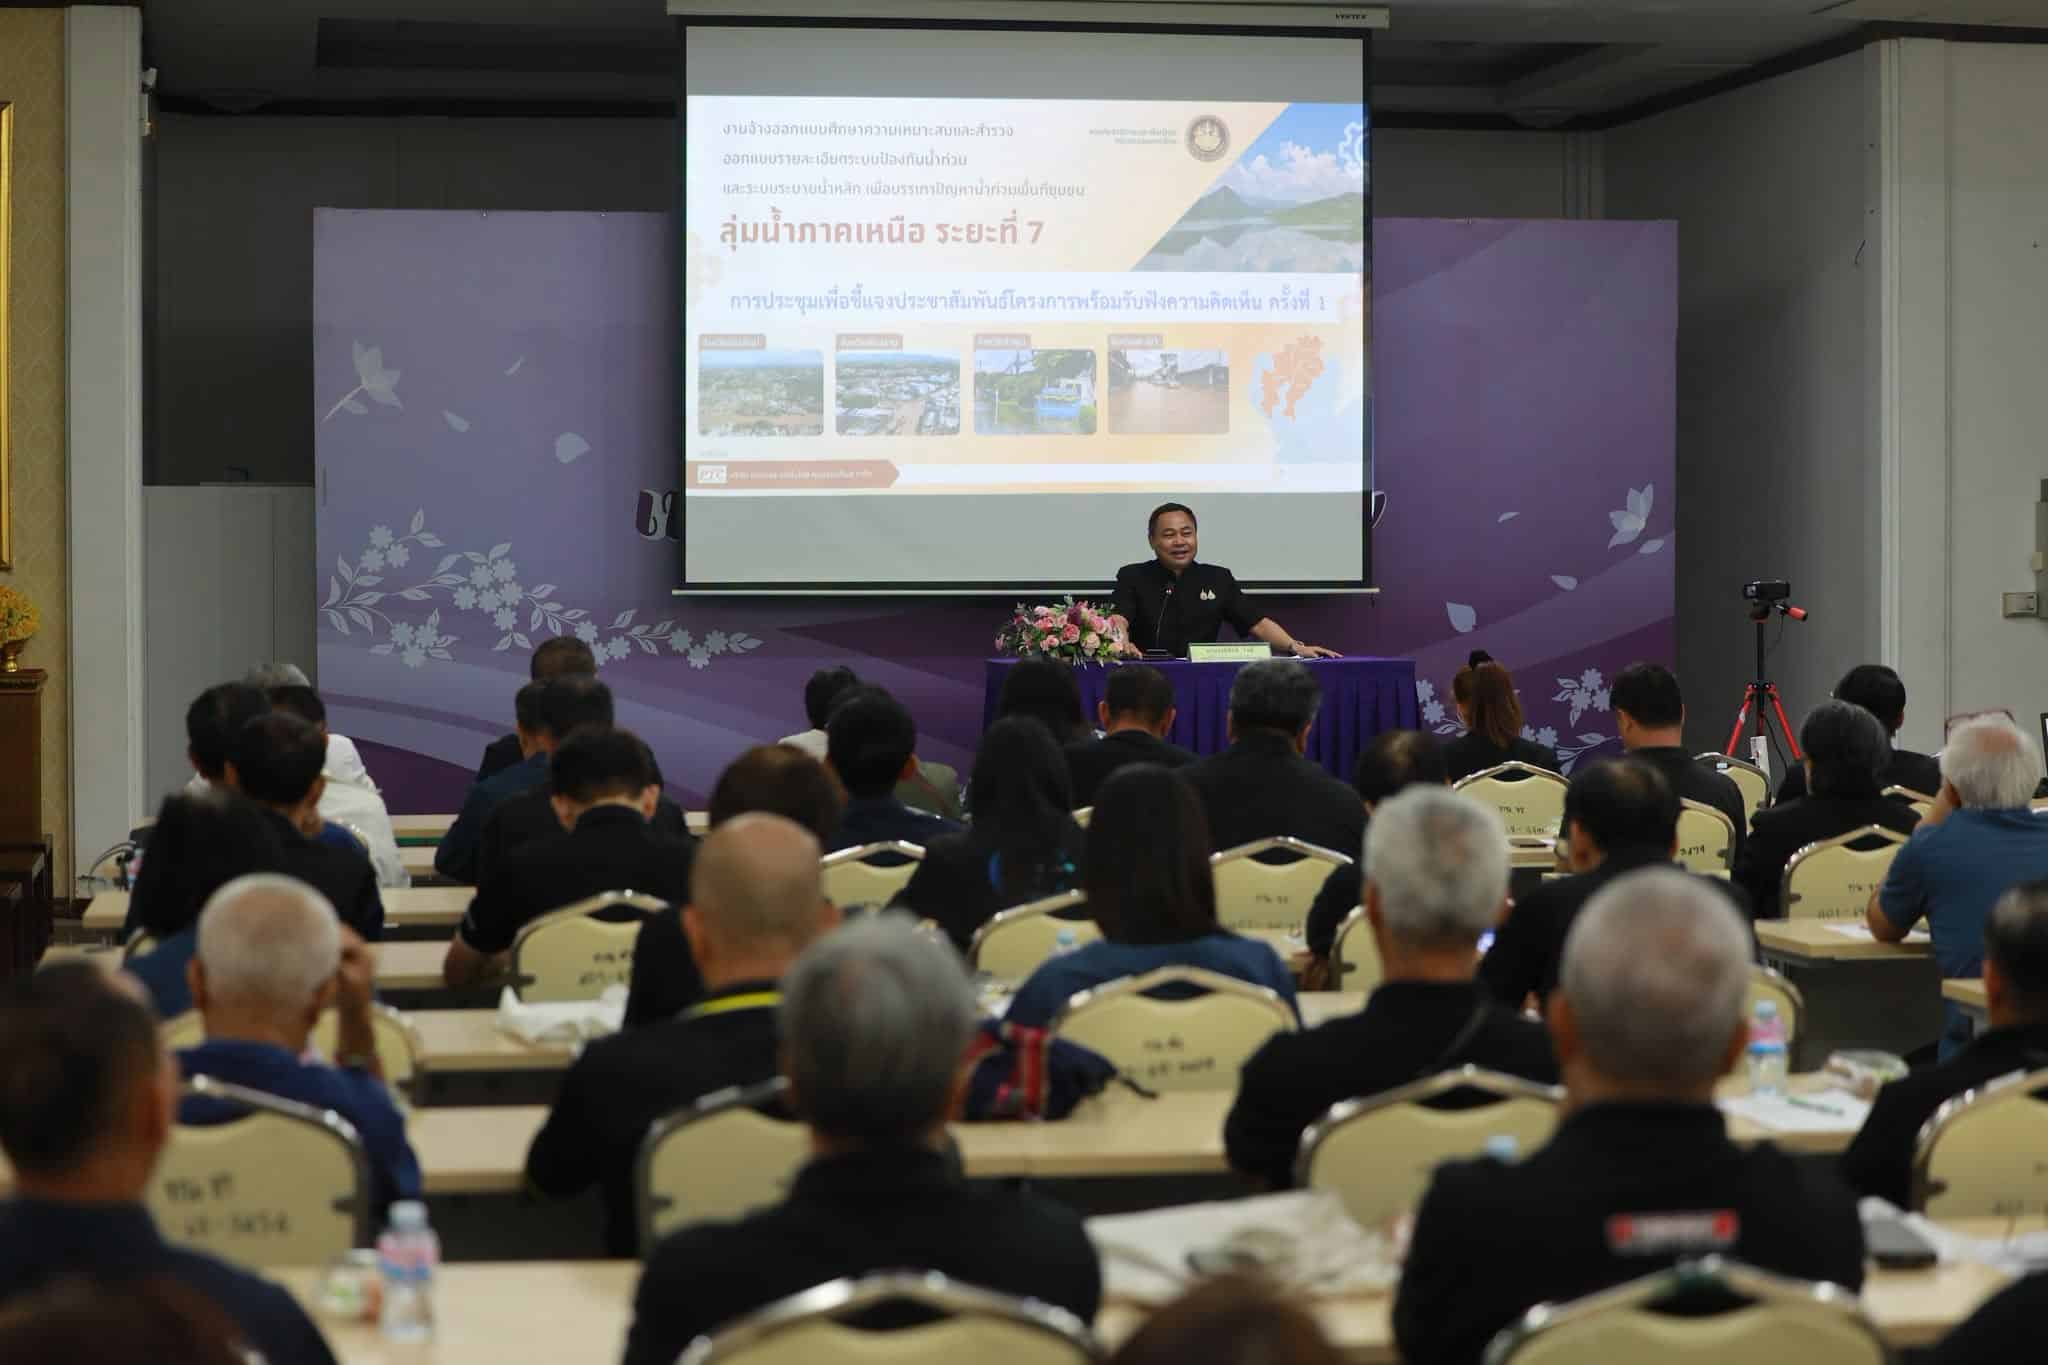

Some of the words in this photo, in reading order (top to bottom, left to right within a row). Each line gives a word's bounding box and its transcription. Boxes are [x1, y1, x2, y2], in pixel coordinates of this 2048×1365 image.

[719, 206, 926, 252] ลุ่มน้ำภาคเหนือ
[935, 209, 1019, 246] ระยะที่
[1027, 220, 1045, 245] 7
[1268, 284, 1311, 311] ครั้งที่
